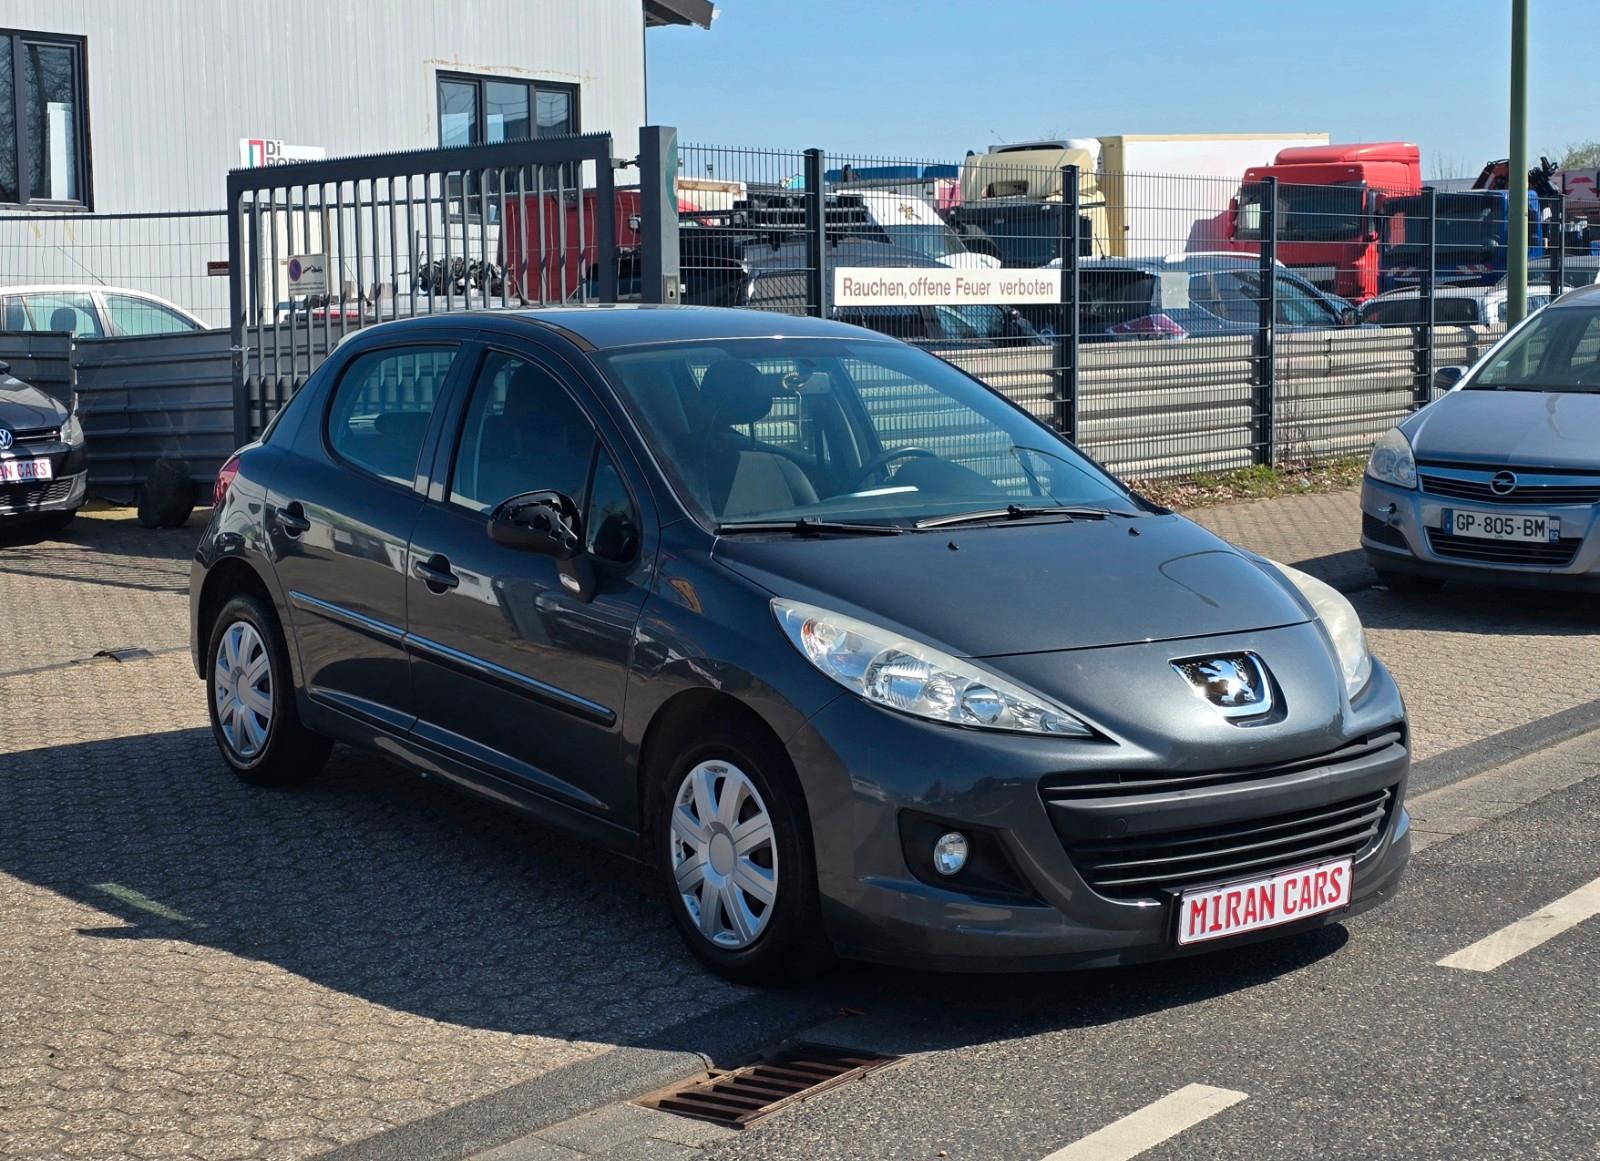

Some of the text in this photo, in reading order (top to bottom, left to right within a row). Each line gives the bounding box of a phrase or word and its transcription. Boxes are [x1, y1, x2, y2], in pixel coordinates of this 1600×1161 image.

[266, 141, 281, 156] Di
[955, 277, 991, 296] Feuer
[999, 278, 1054, 296] verboten
[17, 462, 47, 478] CARS
[1189, 866, 1343, 936] MIRAN CARS
